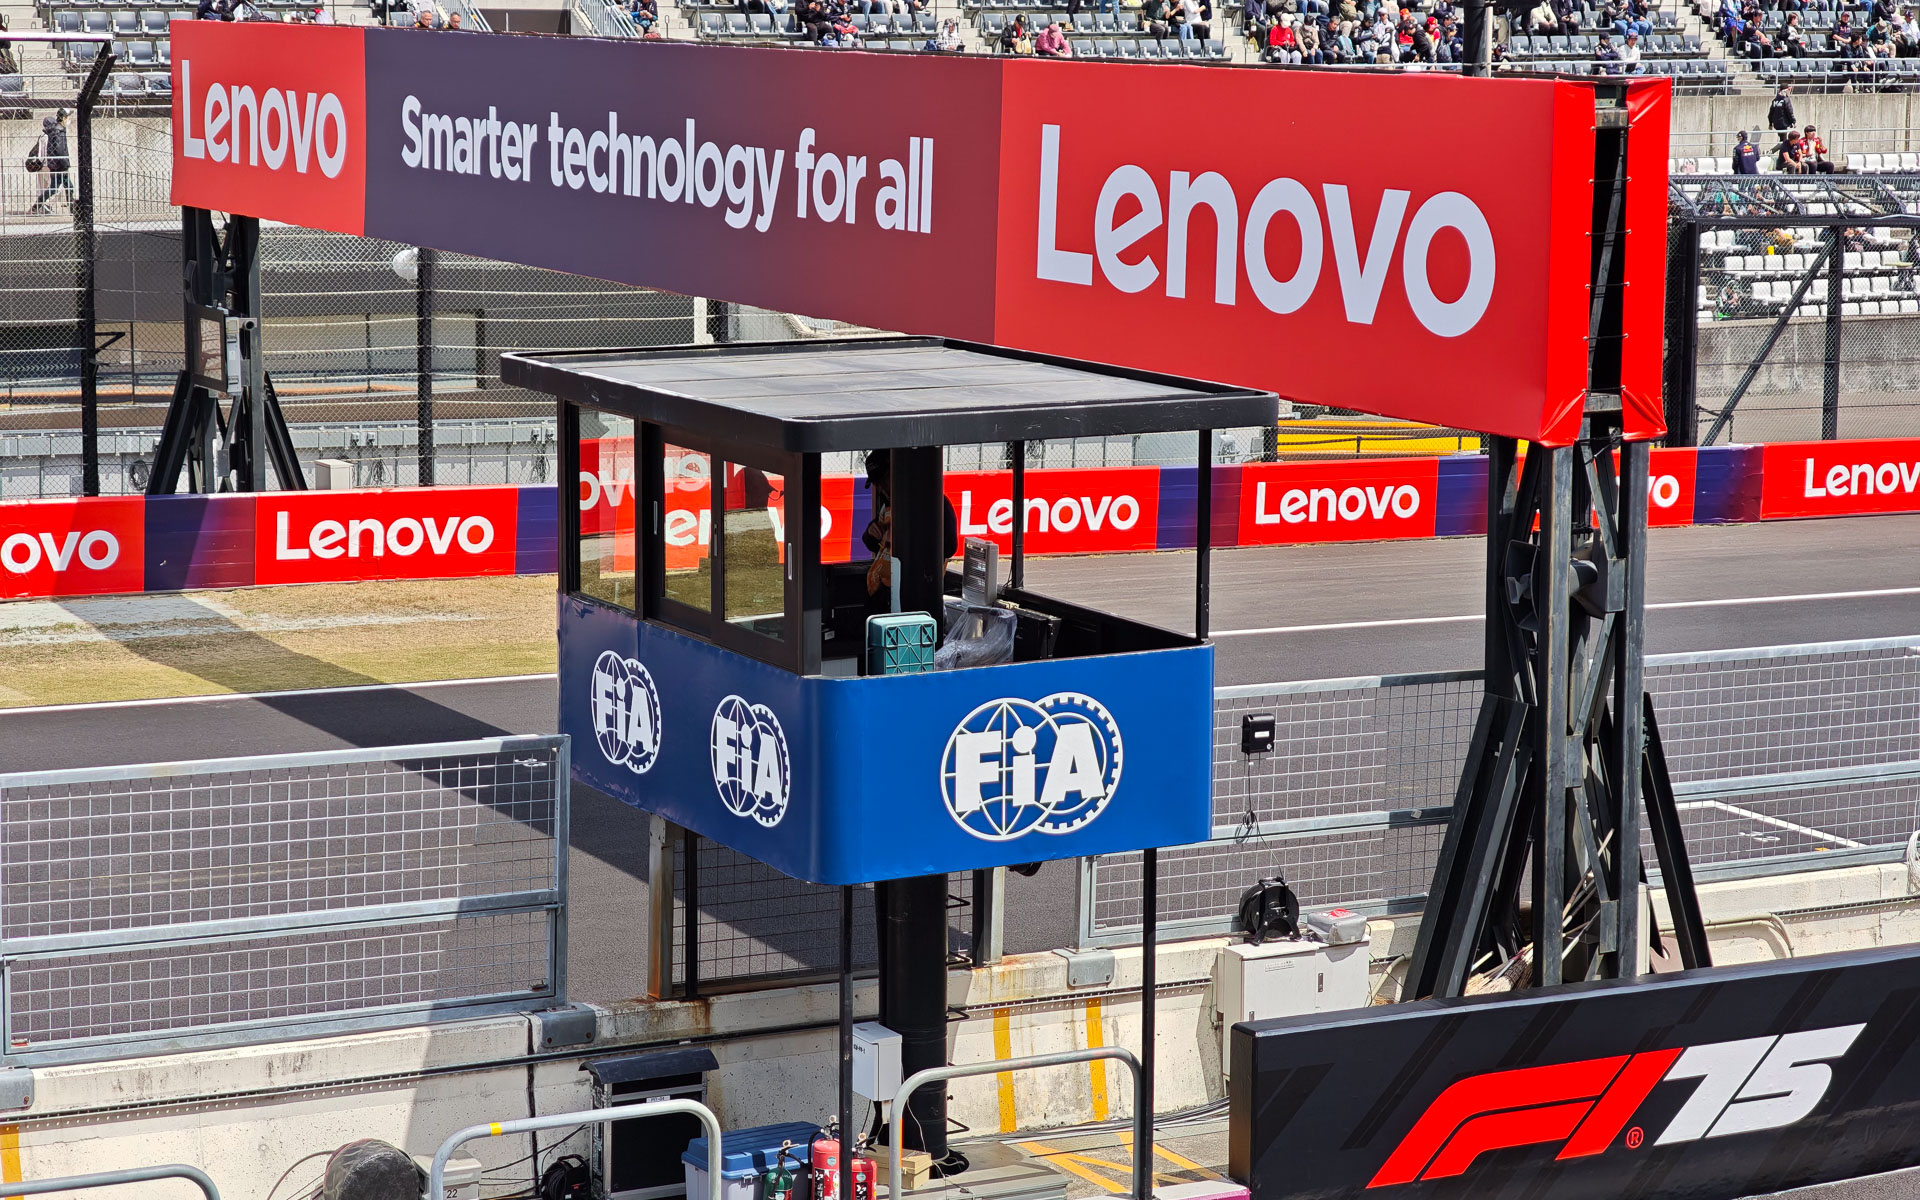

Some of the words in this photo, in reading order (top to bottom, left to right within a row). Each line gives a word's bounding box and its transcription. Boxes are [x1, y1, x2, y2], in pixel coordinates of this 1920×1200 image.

[182, 60, 347, 179] Lenovo
[401, 94, 538, 183] Smarter
[547, 111, 785, 233] technology
[795, 128, 868, 224] for
[875, 136, 934, 234] all
[1037, 124, 1496, 338] Lenovo
[276, 510, 495, 561] Lenovo
[959, 490, 1140, 536] Lenovo
[1255, 482, 1420, 525] Lenovo
[1366, 1047, 1683, 1189] F1
[1653, 1022, 1868, 1147] 75
[446, 1188, 458, 1199] 22
